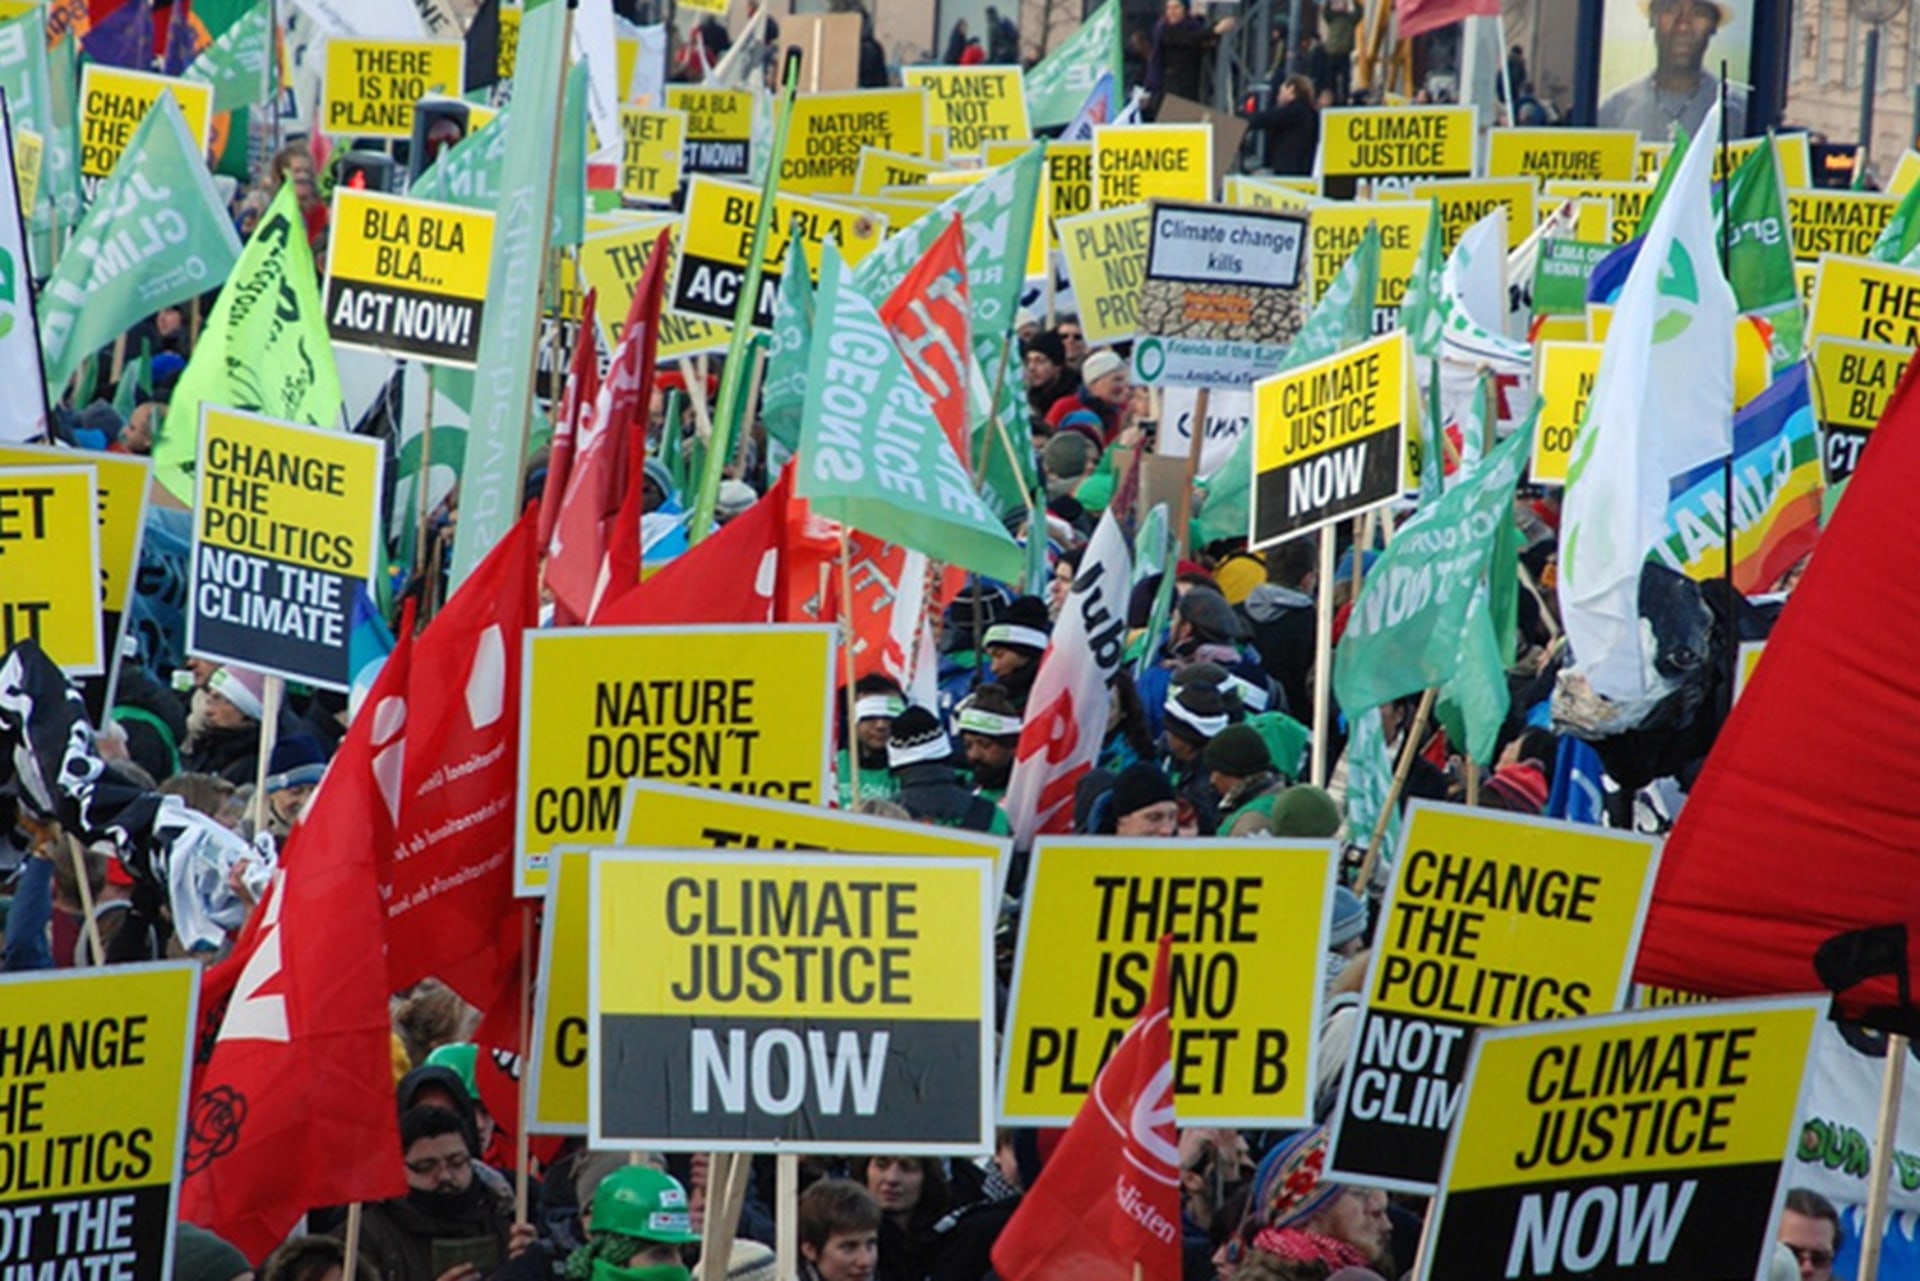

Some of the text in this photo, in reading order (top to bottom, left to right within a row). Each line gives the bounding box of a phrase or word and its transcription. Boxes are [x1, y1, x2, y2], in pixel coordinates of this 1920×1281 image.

[354, 49, 431, 74] THERE
[359, 77, 424, 99] IS NO
[680, 95, 737, 113] BLA BLA
[921, 75, 1006, 99] PLANET
[331, 102, 411, 127] PLANE
[809, 112, 889, 133] NATURE
[946, 101, 988, 123] NOT
[1349, 115, 1448, 142] CLIMATE
[683, 145, 745, 168] CT NOW!
[949, 127, 1009, 149] ROFIT
[1099, 148, 1189, 171] CHANGE
[1350, 142, 1444, 168] JUSTICE
[1523, 151, 1601, 170] NATURE
[1100, 174, 1140, 197] THE
[363, 208, 465, 254] BLA BLA
[1160, 218, 1294, 255] Climate change
[1314, 226, 1410, 250] CHAGE
[376, 247, 443, 287] BLA...
[1104, 253, 1146, 290] NOT
[1207, 252, 1242, 274] kills
[333, 288, 473, 346] ACT NOW!
[1167, 339, 1212, 356] Friends
[1839, 354, 1886, 389] BLA
[1282, 353, 1380, 418] CLIMATE
[1284, 392, 1377, 456] JUSTICE
[207, 437, 346, 496] CHANGE
[1288, 442, 1368, 518] NOW
[206, 471, 270, 517] THE
[203, 507, 353, 570] POLITICS
[200, 546, 342, 611] NOT THE
[199, 582, 345, 648] CLIMATE
[595, 680, 754, 728] NATURE
[665, 876, 918, 939] CLIMATE
[1094, 876, 1263, 943] THERE
[1403, 849, 1601, 924] CHANGE
[1396, 902, 1485, 960] THE
[671, 944, 911, 1004] JUSTICE
[1093, 952, 1238, 1020] IS NO
[0, 1015, 148, 1077] HANGE
[1253, 1029, 1289, 1096] B
[1361, 1014, 1464, 1076] NOT
[1527, 1027, 1756, 1105] CLIMATE
[691, 1028, 889, 1116] NOW
[1351, 1067, 1463, 1131] CLIM
[1515, 1094, 1735, 1171] JUSTICE
[52, 1195, 136, 1256] THE
[1505, 1179, 1698, 1280] NOW
